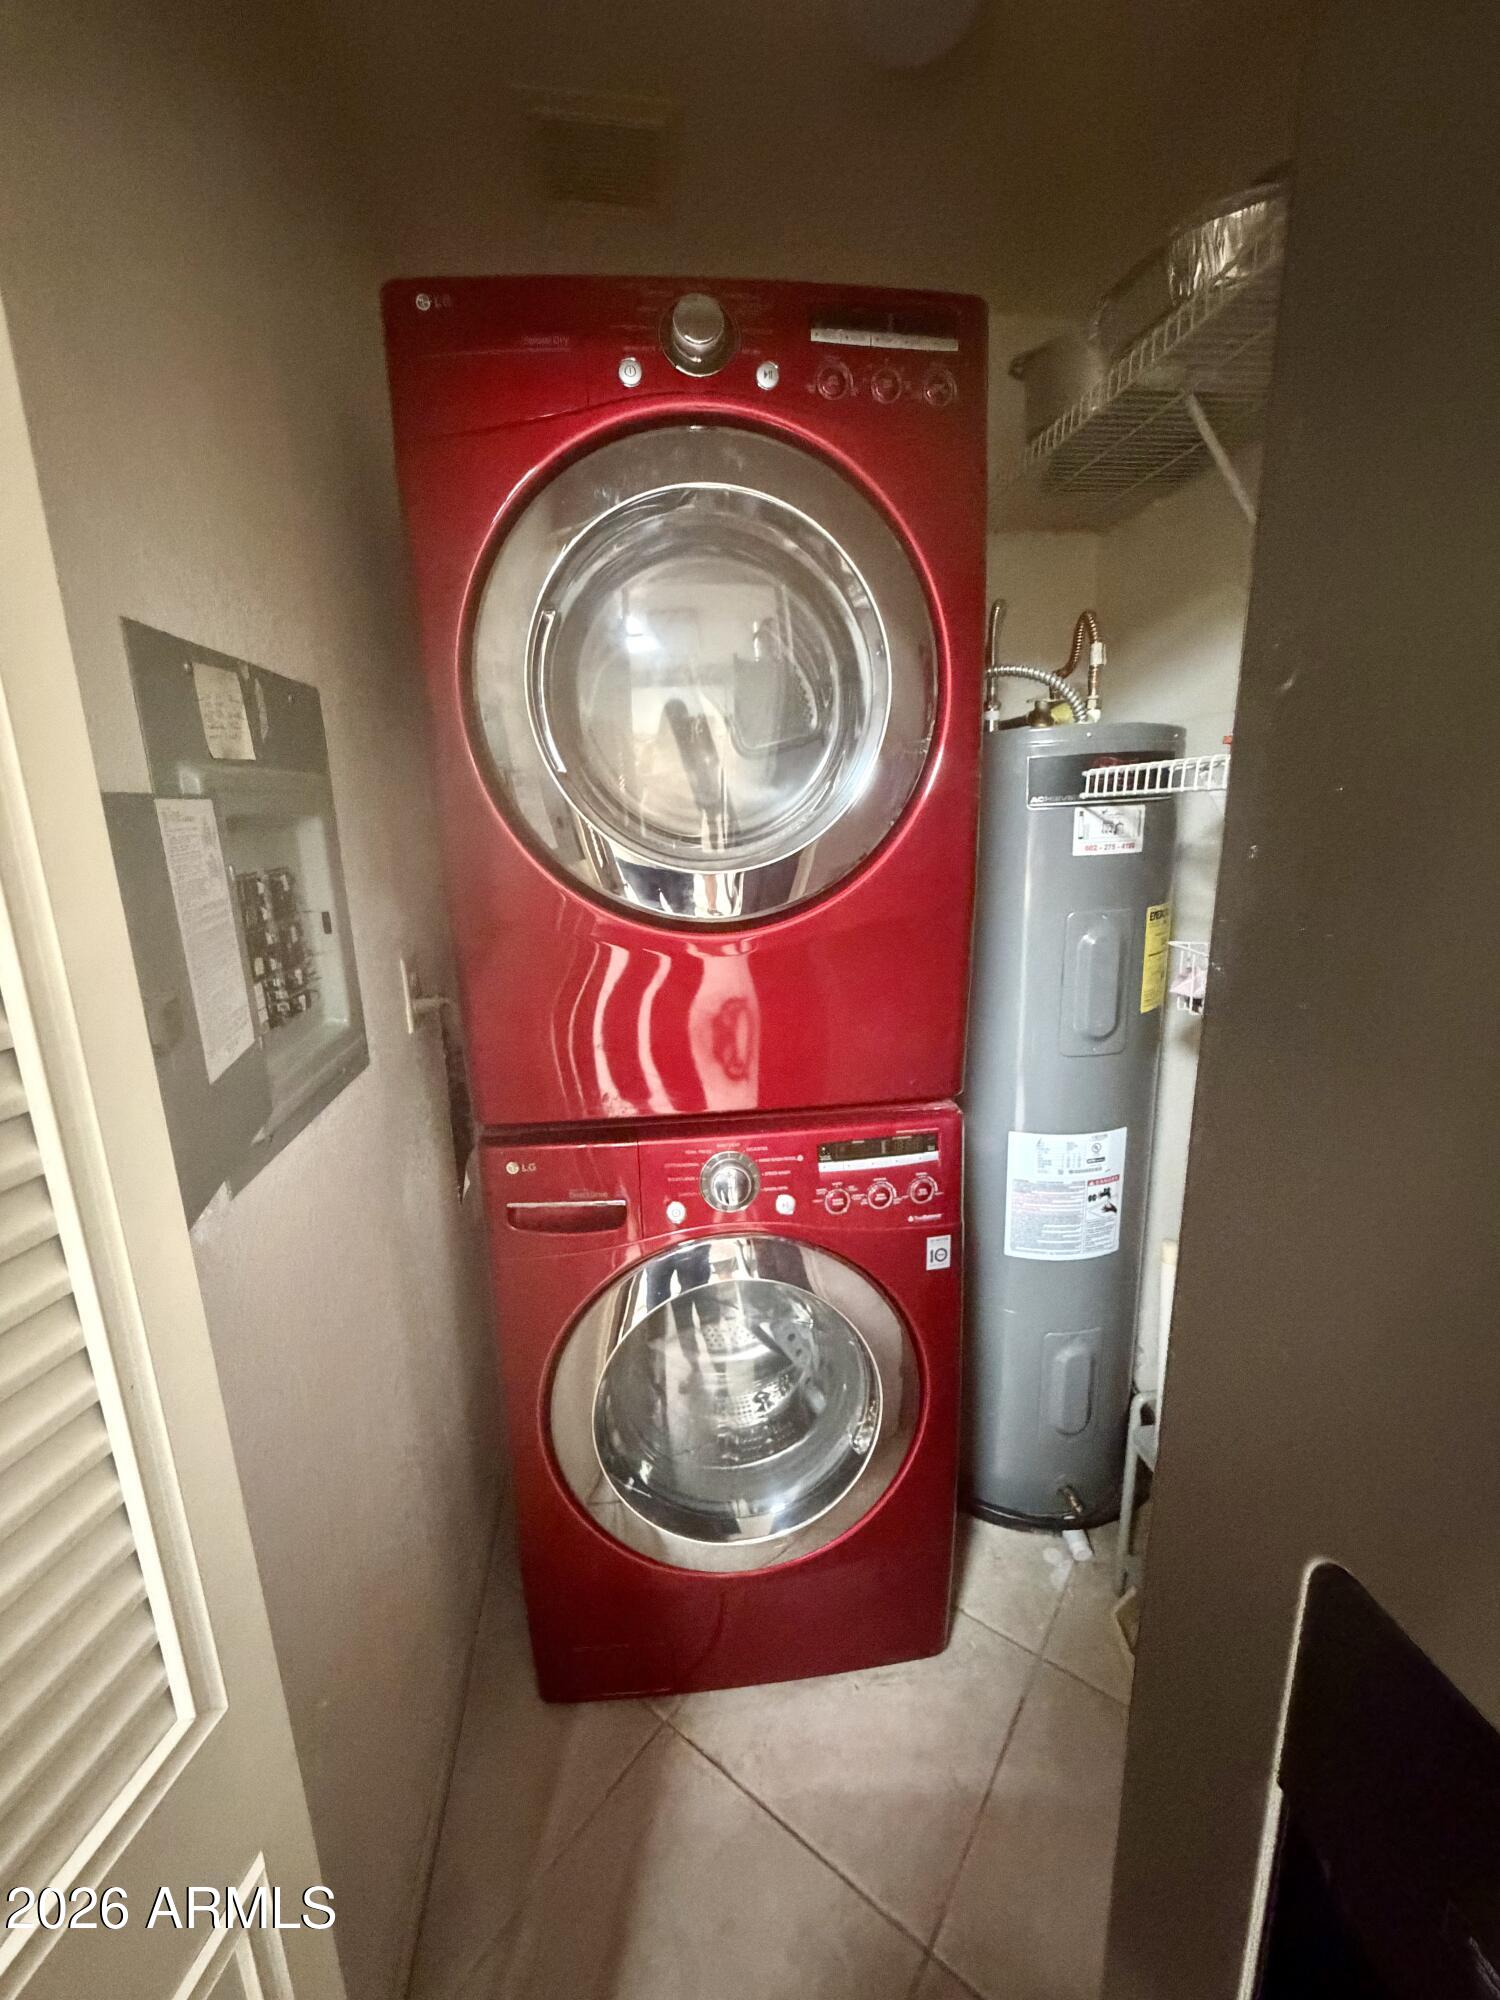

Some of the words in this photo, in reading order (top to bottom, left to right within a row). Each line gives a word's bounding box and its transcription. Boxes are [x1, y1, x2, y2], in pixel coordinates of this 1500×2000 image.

[553, 335, 570, 347] Dry
[521, 1162, 537, 1173] LG
[929, 1247, 948, 1264] 10
